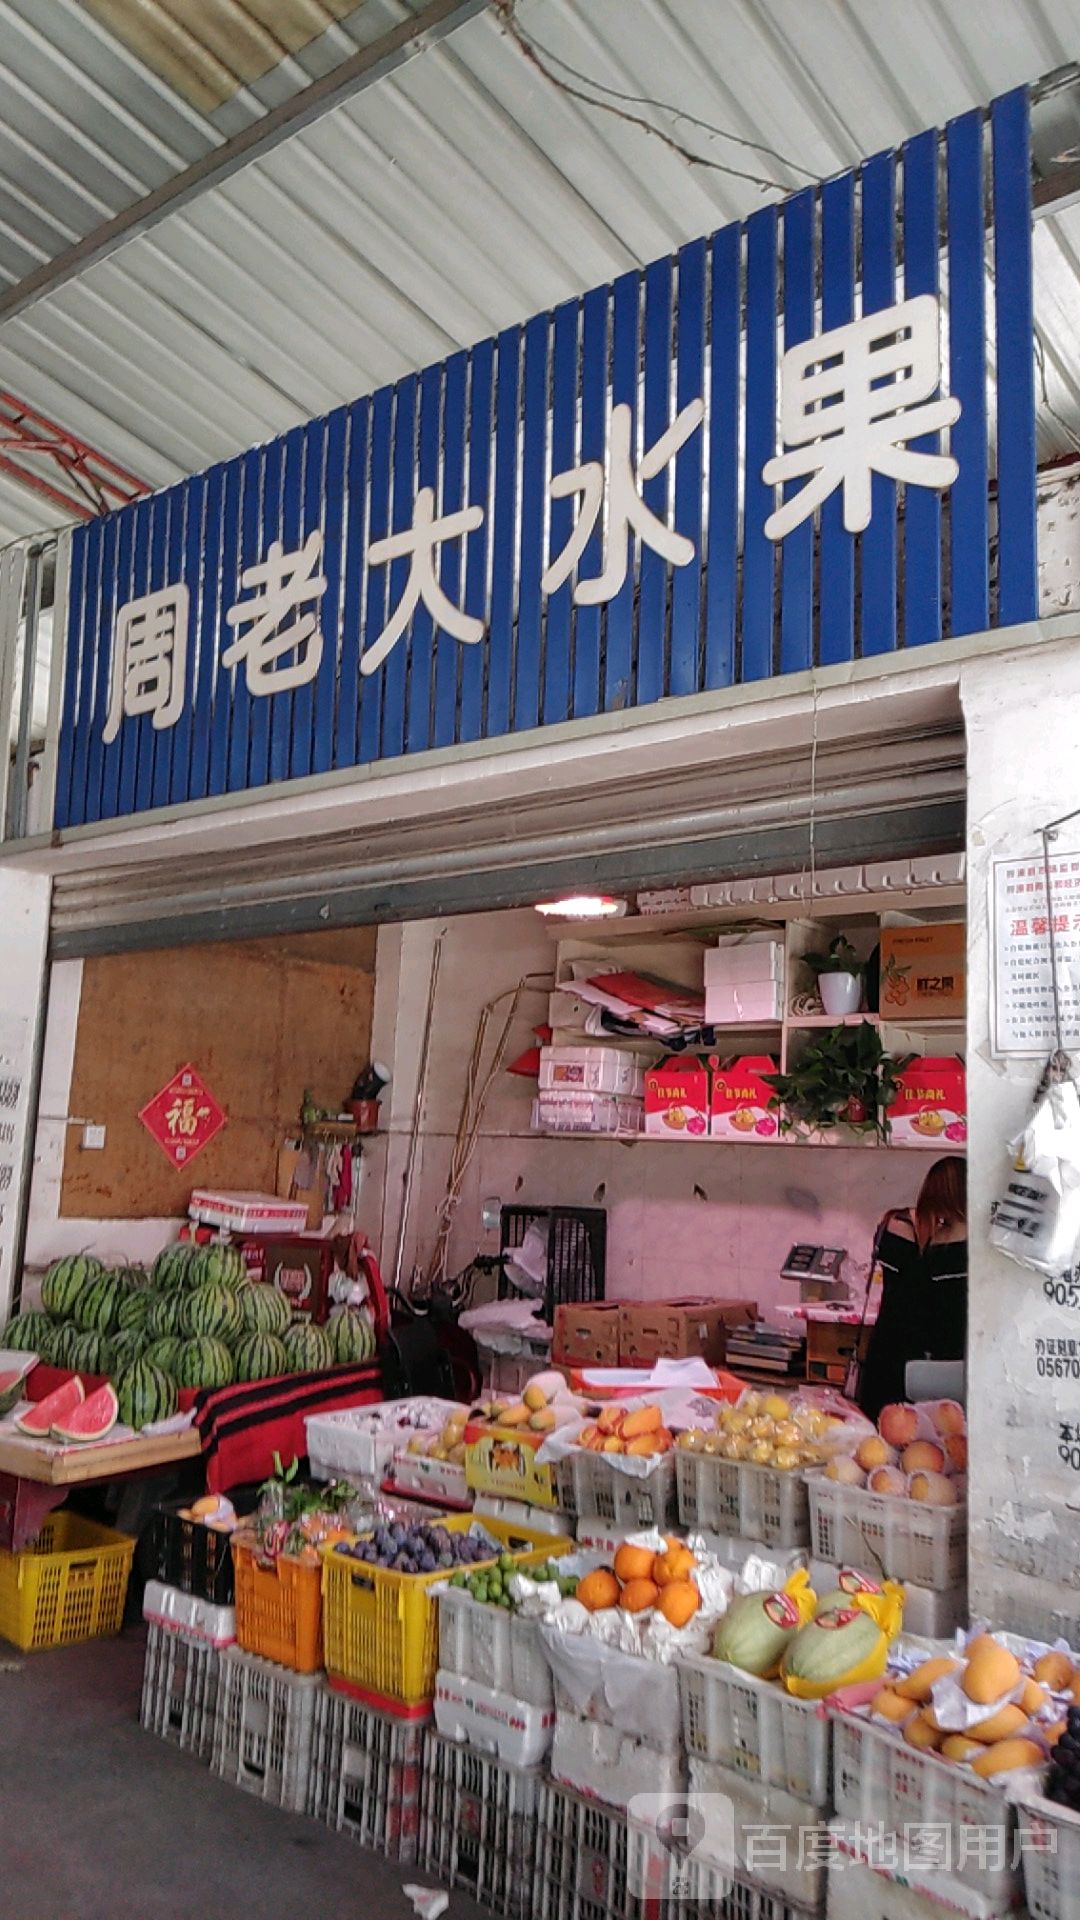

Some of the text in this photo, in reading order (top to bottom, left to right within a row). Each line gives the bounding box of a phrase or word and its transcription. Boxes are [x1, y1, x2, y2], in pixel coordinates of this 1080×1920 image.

[101, 293, 963, 745] 周老大水果
[165, 1097, 199, 1137] 福
